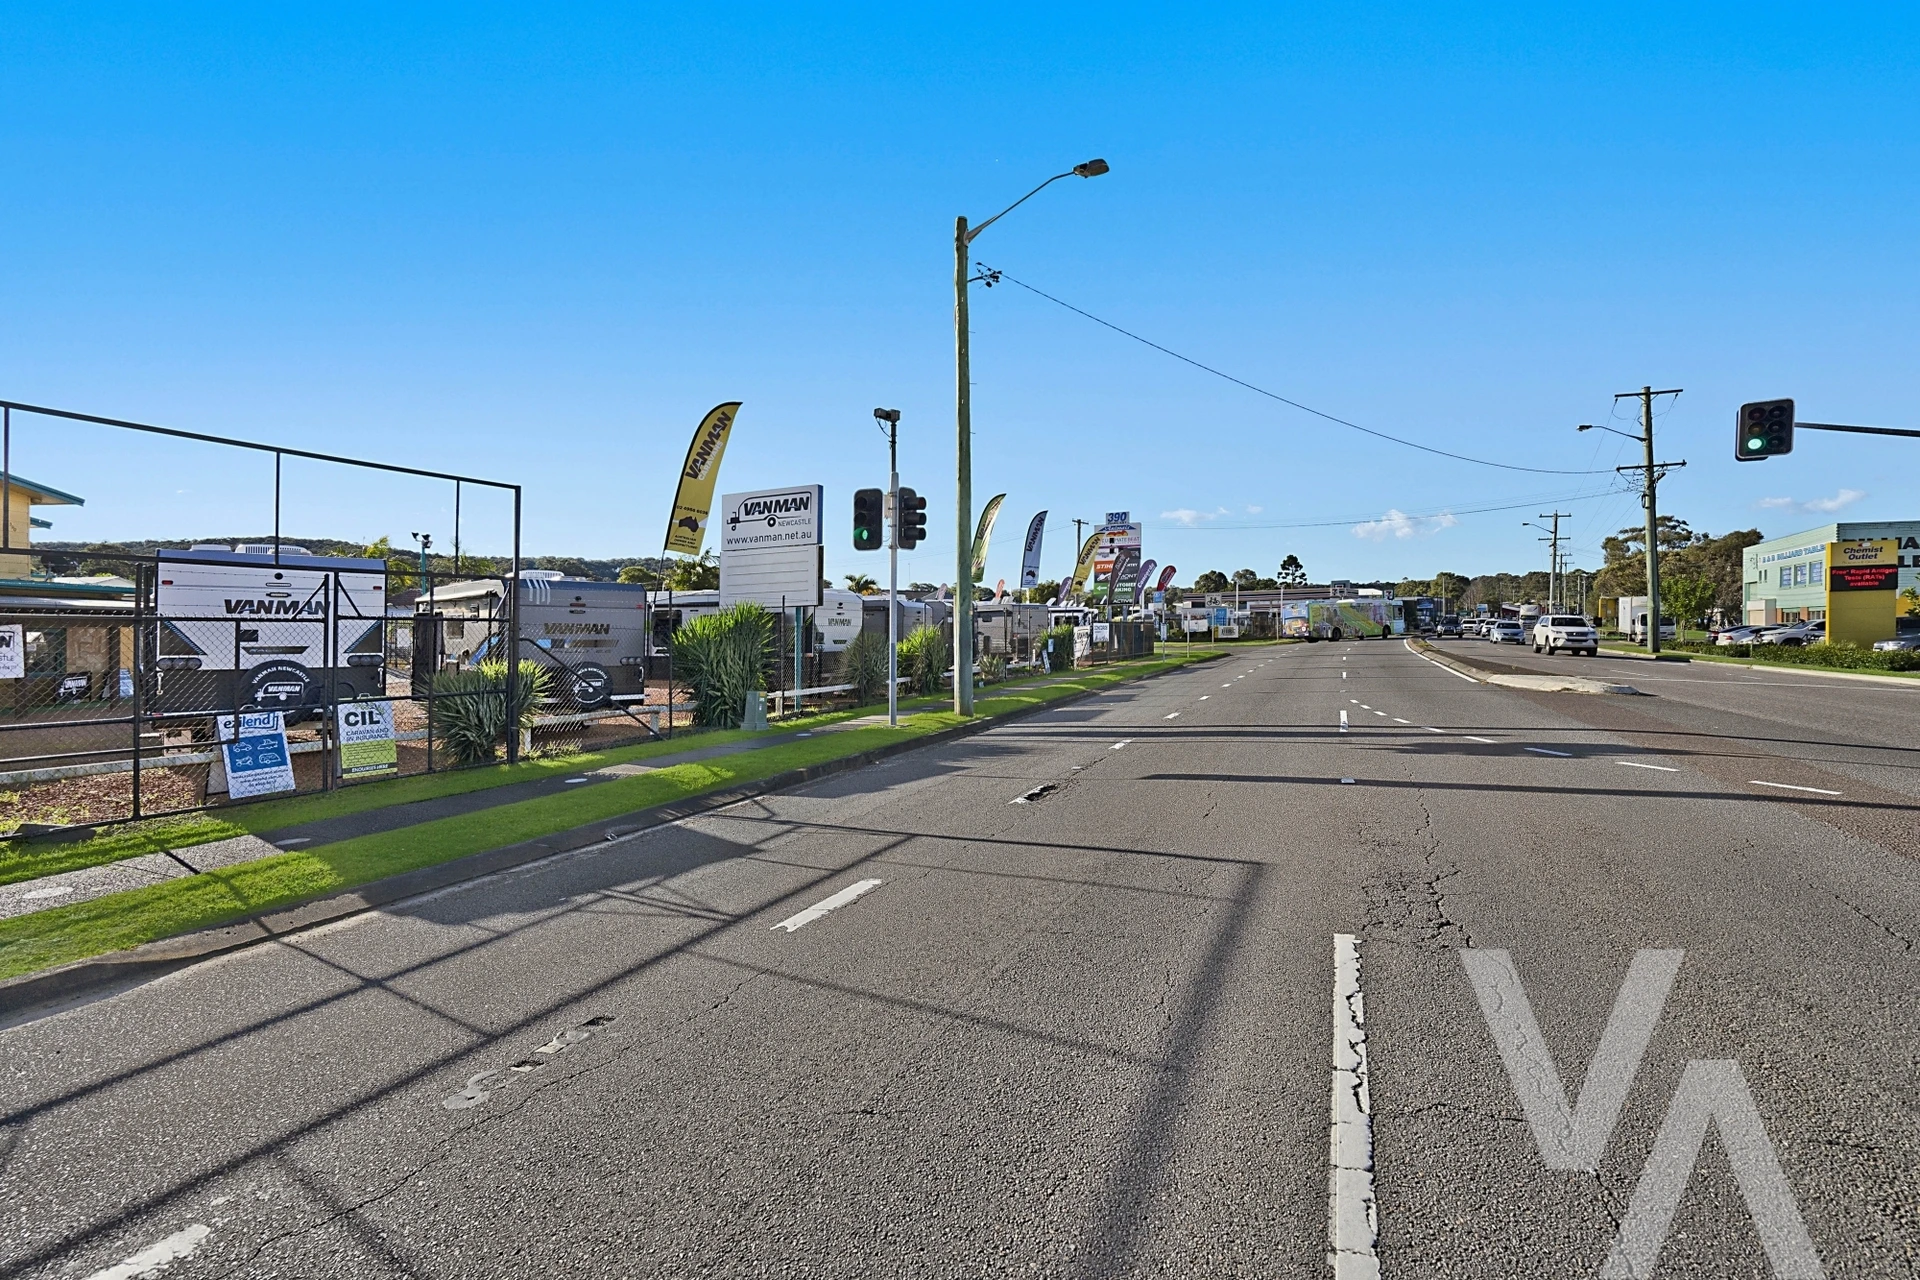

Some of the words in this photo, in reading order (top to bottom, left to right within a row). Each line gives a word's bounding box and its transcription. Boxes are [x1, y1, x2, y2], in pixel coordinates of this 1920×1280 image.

[684, 411, 732, 480] VANMAN
[744, 496, 810, 516] VANMAN
[778, 518, 811, 527] NEWCASTLE
[1108, 512, 1127, 522] 390
[727, 531, 812, 545] www.vanman.net.au
[1026, 516, 1045, 552] VANMAN
[1079, 536, 1100, 566] VANMAN
[1843, 546, 1883, 554] Chemist
[224, 599, 330, 615] VANMAN
[828, 618, 852, 626] VANMAN
[252, 666, 277, 684] VANMAN
[278, 666, 311, 683] NEWCASTLE
[344, 711, 381, 727] CIL
[346, 729, 375, 737] CARAVAN
